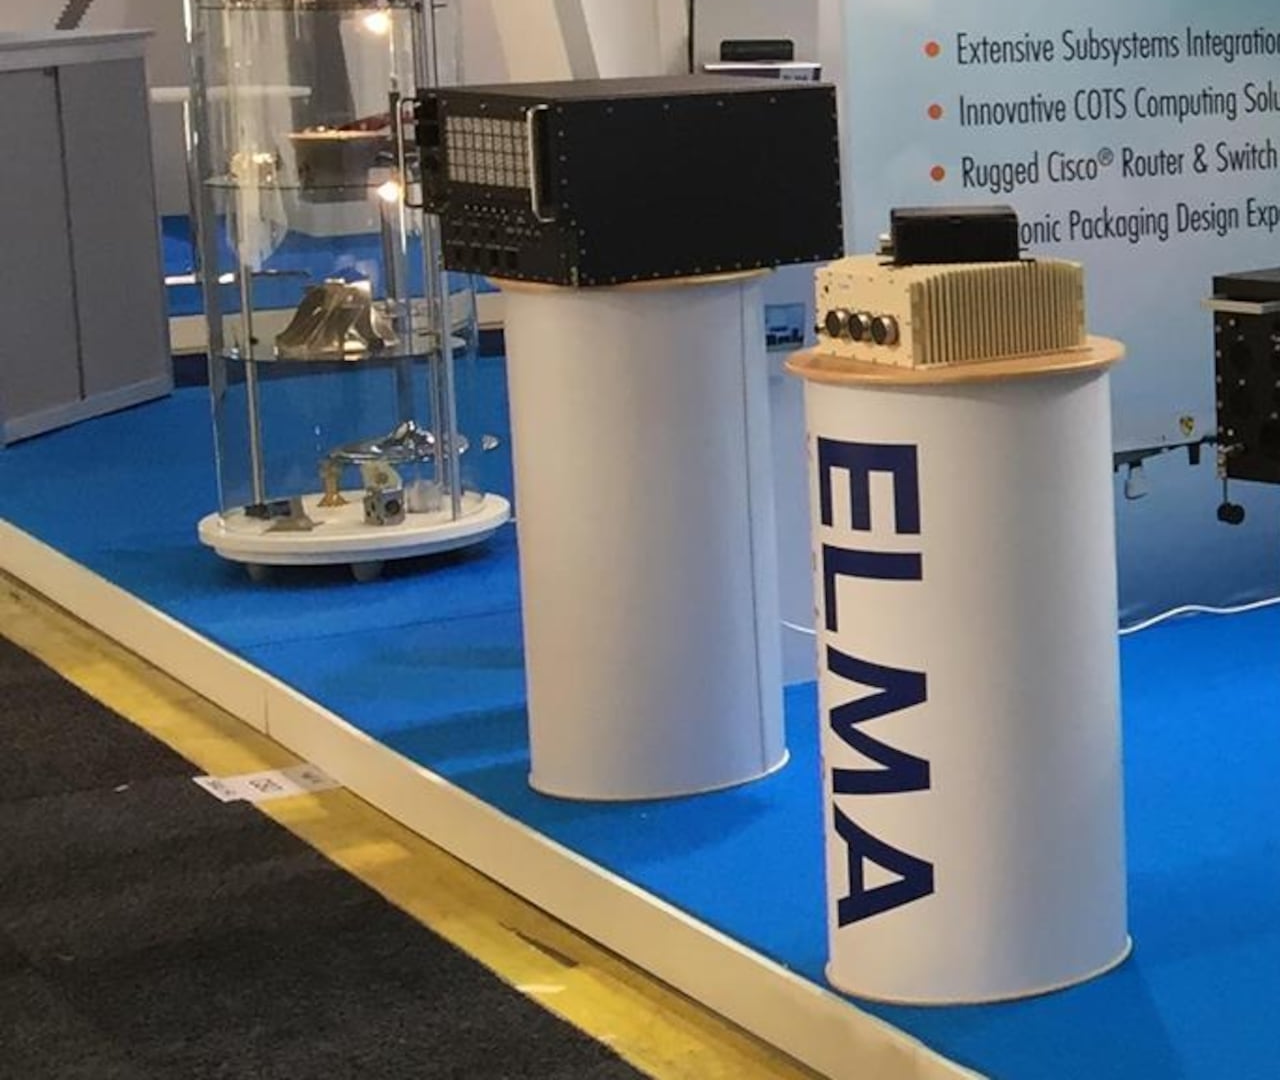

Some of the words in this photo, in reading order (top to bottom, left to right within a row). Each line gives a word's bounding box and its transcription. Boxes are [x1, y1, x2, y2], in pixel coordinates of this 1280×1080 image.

[957, 31, 1054, 65] Extensive
[1062, 26, 1180, 67] Subsystems
[959, 92, 1066, 126] Innovative
[1074, 87, 1127, 121] COTS
[1134, 84, 1238, 122] Computing
[962, 151, 1039, 194] Rugged
[1122, 146, 1185, 179] Router
[1193, 143, 1209, 174] &
[1216, 139, 1278, 173] Switch
[1069, 205, 1169, 246] Packaging
[1177, 201, 1240, 237] Design
[817, 436, 935, 929] ELMA
